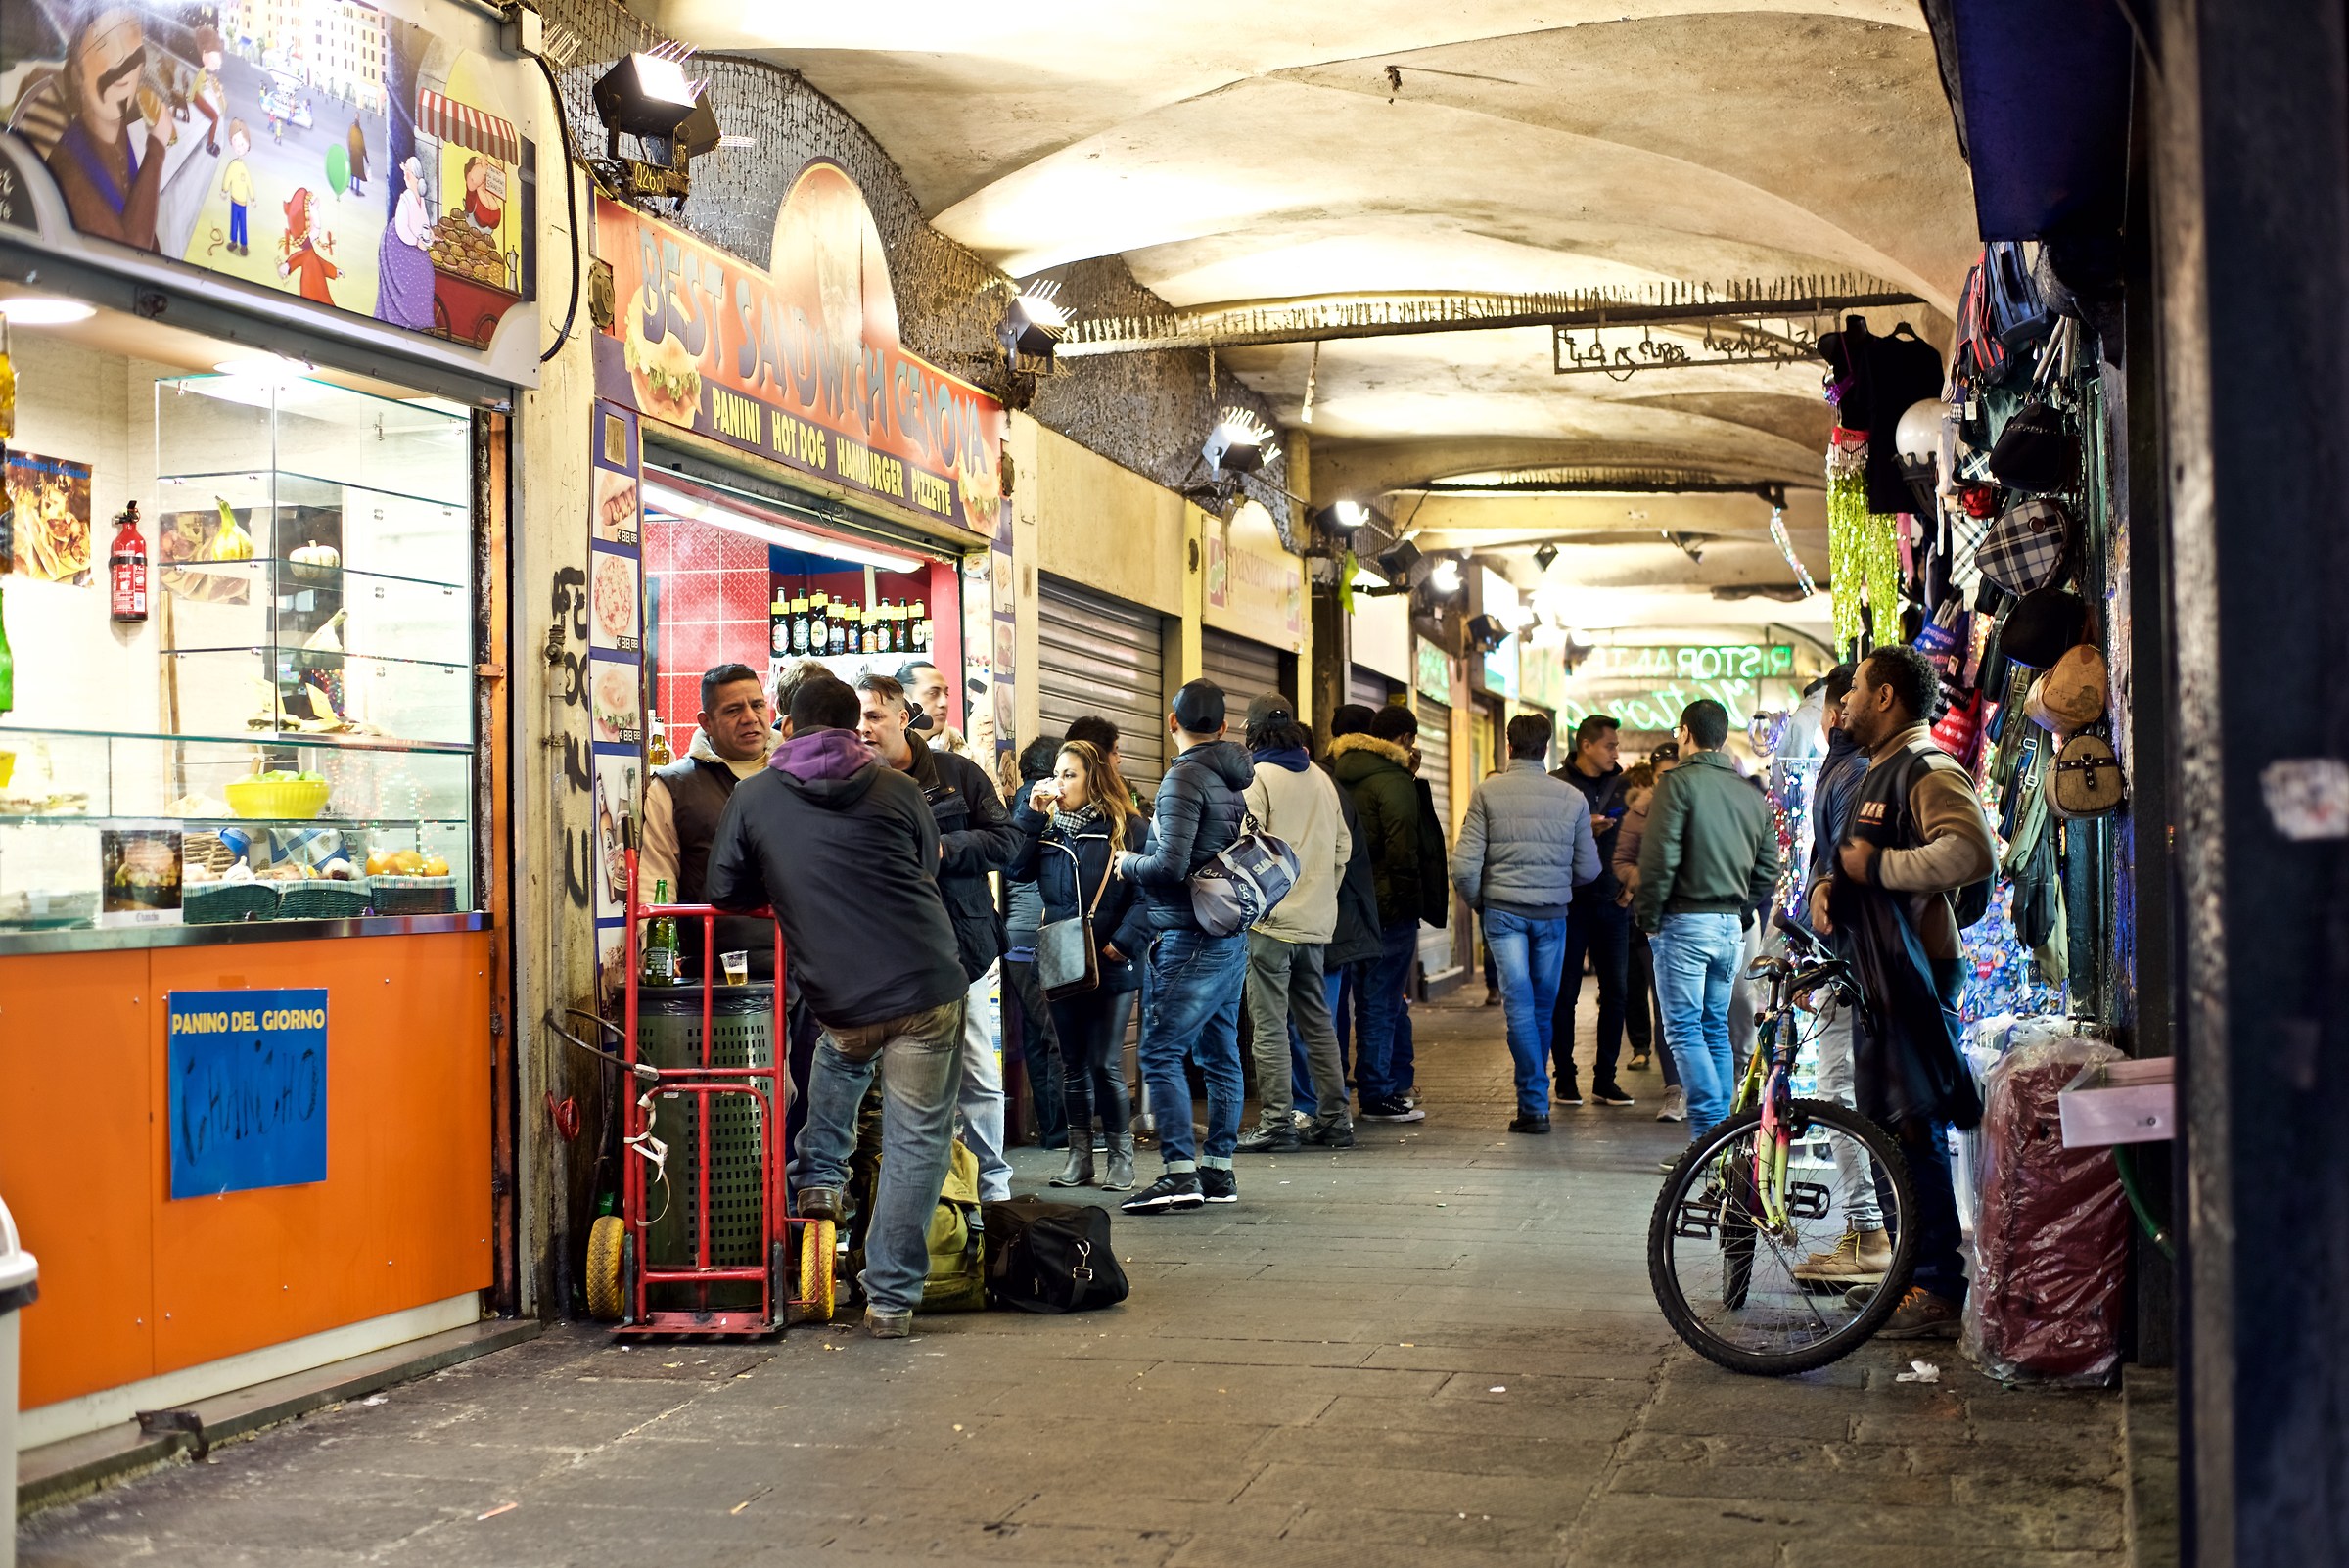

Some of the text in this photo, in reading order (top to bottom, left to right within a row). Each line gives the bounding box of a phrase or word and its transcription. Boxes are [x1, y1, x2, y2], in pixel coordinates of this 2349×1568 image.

[640, 226, 989, 479] BEST SANDWICH GENOVA
[712, 387, 952, 517] PANINI HOT DOG HAMBURGER PIZZETTE
[171, 1008, 326, 1035] PANINO DEL GIORNO
